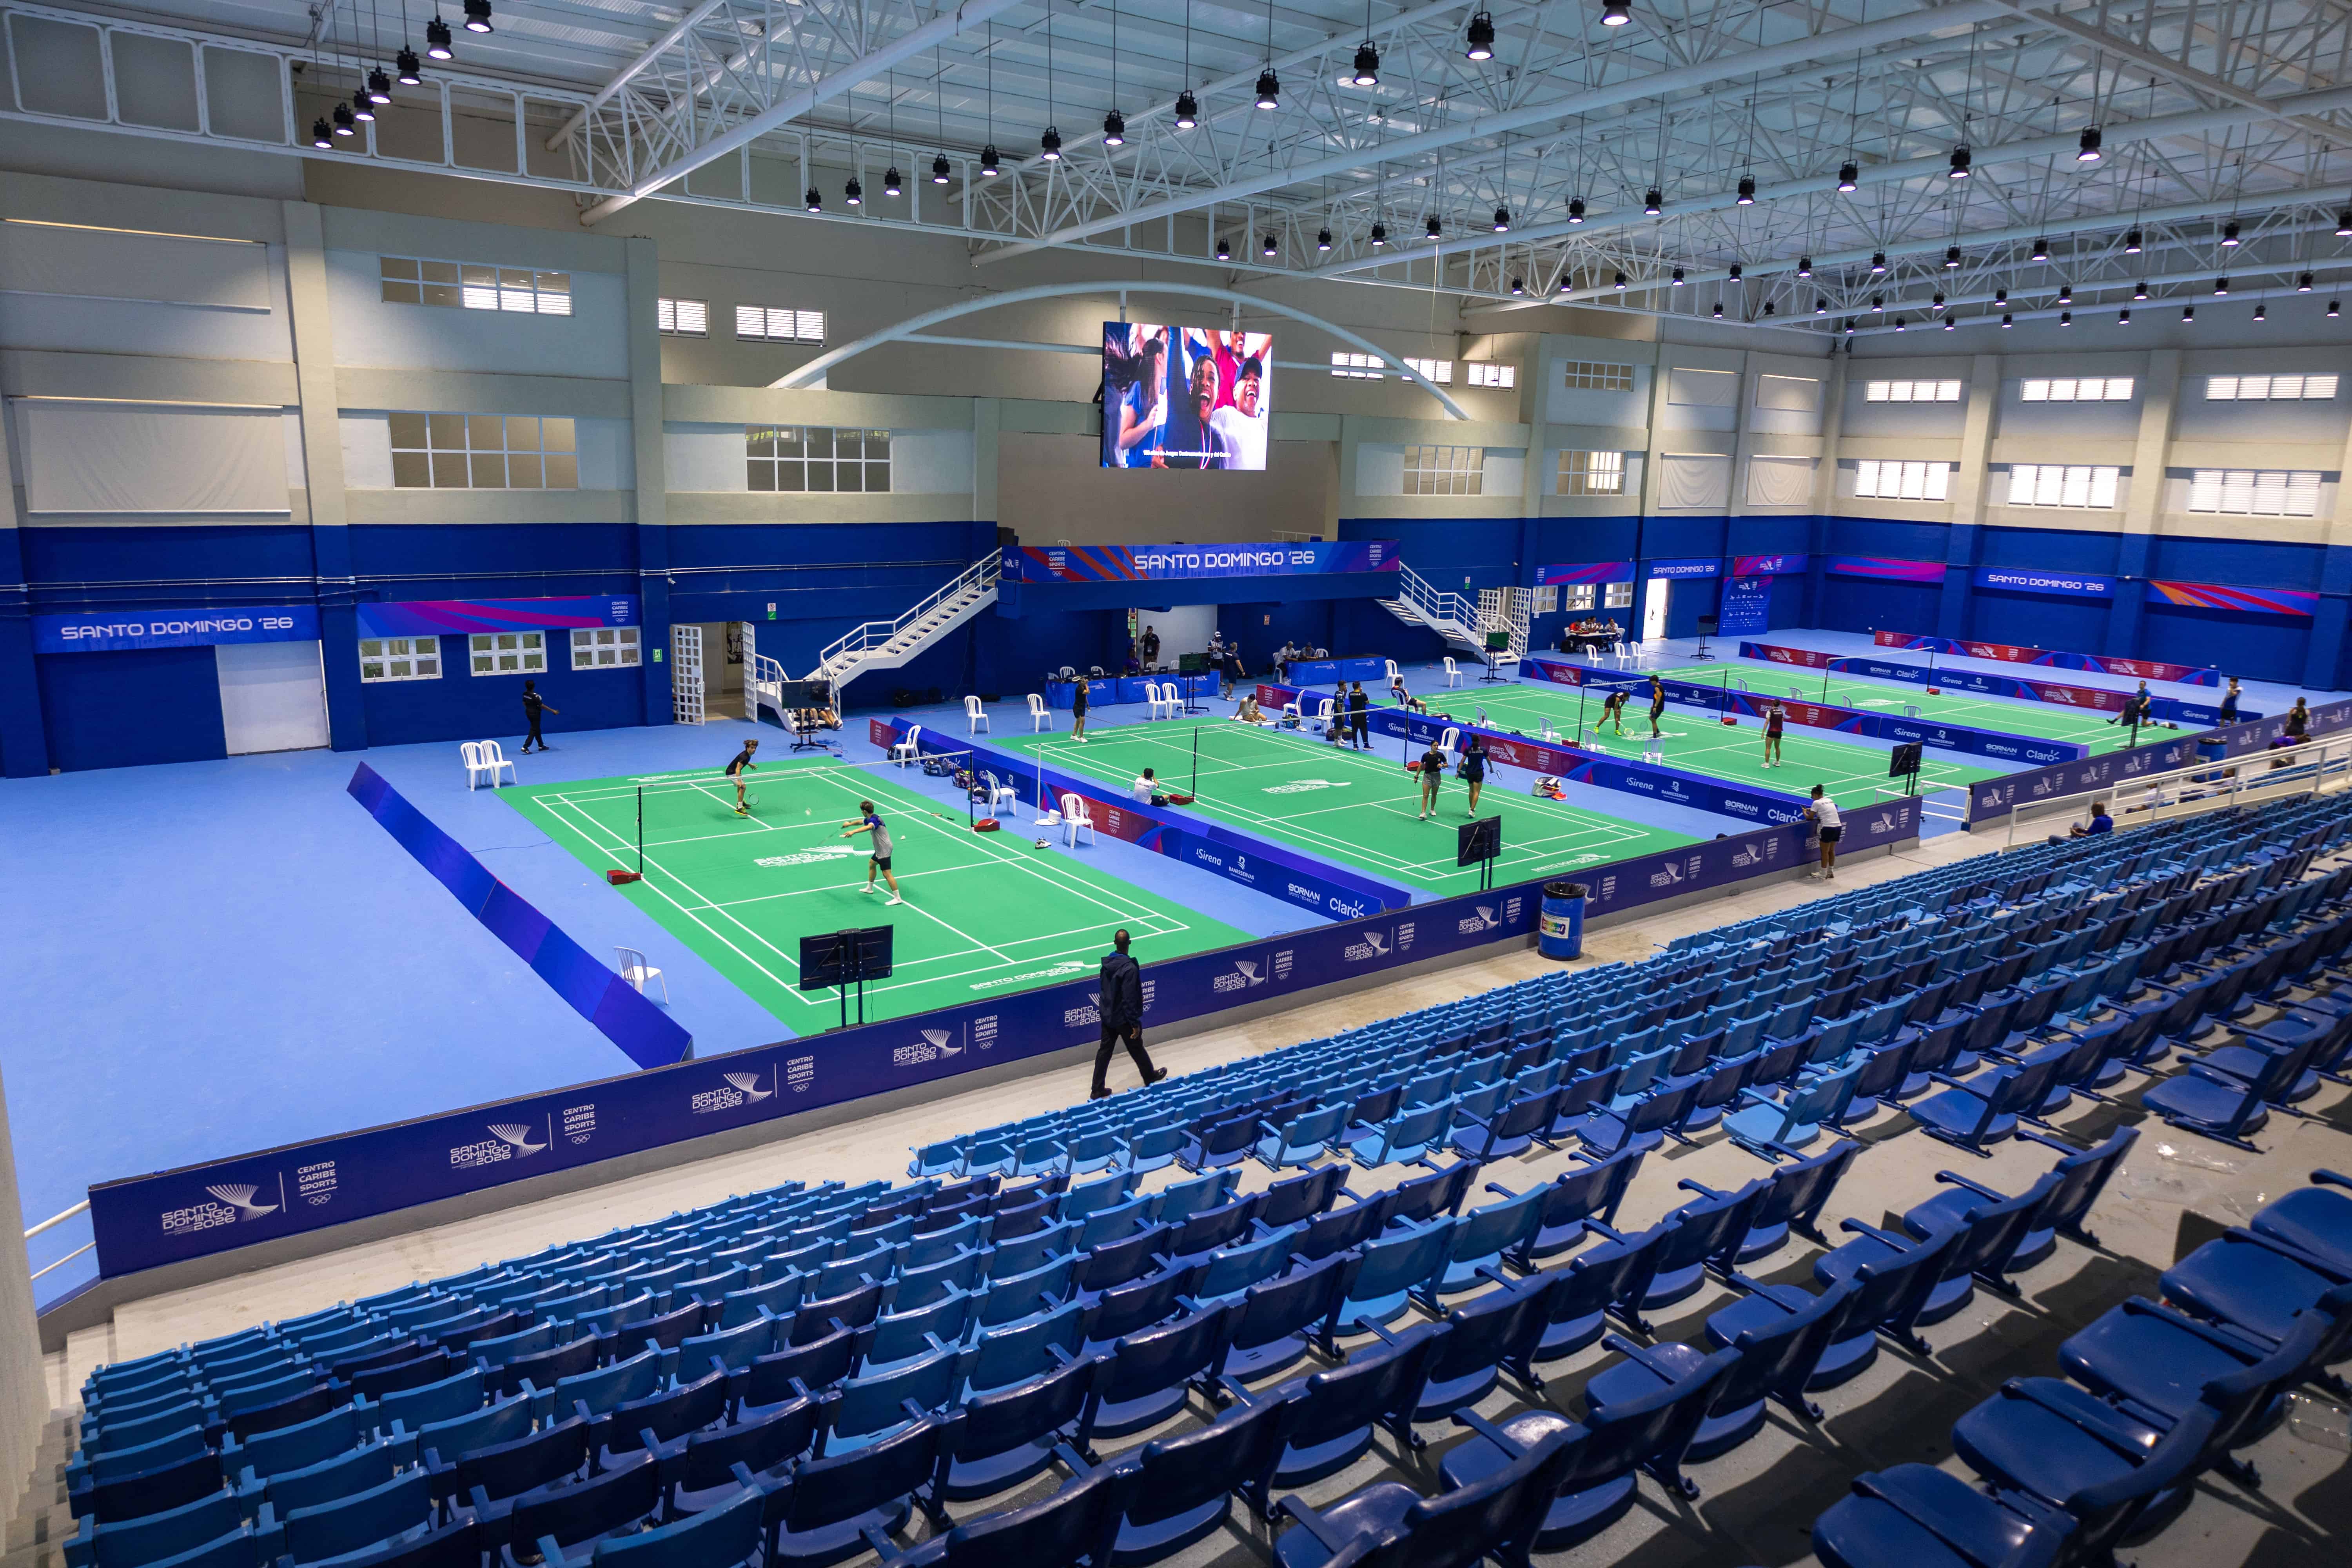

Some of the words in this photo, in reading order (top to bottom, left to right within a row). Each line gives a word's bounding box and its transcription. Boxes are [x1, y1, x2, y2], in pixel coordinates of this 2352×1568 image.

[1135, 554, 1200, 570] SANTO
[1205, 551, 1283, 567] DOMINGO
[1288, 550, 1315, 564] '26
[1988, 574, 2026, 585] SANTO
[2029, 577, 2082, 590] DOMINGO
[2084, 582, 2104, 591] '26
[61, 623, 144, 640] SANTO
[151, 618, 252, 635] DOMINGO
[258, 617, 294, 630] '26
[1896, 670, 1915, 679] Claro
[1664, 690, 1680, 698] irena
[1489, 748, 1508, 757] DOMINGO
[1985, 744, 2018, 753] BORNAN
[2026, 749, 2054, 761] Claro
[1661, 789, 1689, 800] BANRESERVAS
[1725, 800, 1758, 813] BORNAN
[1768, 809, 1798, 823] Claro
[1229, 866, 1254, 880] BANRESERVAS
[1288, 883, 1320, 902] BORNAN
[1300, 895, 1320, 906] TECHNOLOGY
[1330, 897, 1359, 918] Claro
[1459, 916, 1479, 926] SANTO
[1459, 920, 1484, 931] DOMINGO
[1345, 943, 1367, 953] SANTO
[1345, 946, 1373, 958] DOMINGO
[1275, 955, 1293, 964] CARIBE
[1356, 952, 1373, 960] 2026
[1275, 962, 1292, 970] SPORTS
[969, 977, 1013, 989] SANTO
[1014, 966, 1069, 979] DOMINGO
[1214, 972, 1239, 982] SANTO
[1214, 976, 1246, 989] DOMINGO
[1227, 982, 1246, 991] 2026
[1065, 1005, 1093, 1016] SANTO
[975, 1015, 998, 1024] CENTRO
[1080, 1015, 1101, 1025] 2026
[975, 1021, 998, 1031] CARIBE
[975, 1028, 998, 1038] SPORTS
[893, 1042, 927, 1055] SANTO
[893, 1046, 936, 1062] DOMINGO
[787, 1055, 813, 1066] CENTRO
[911, 1053, 936, 1065] 2026
[787, 1062, 813, 1073] CARIBE
[787, 1069, 814, 1081] SPORTS
[692, 1087, 731, 1102] SANTO
[692, 1091, 742, 1109] DOMINGO
[563, 1104, 595, 1116] CENTRO
[713, 1098, 742, 1111] 2026
[564, 1111, 595, 1124] CARIBE
[564, 1119, 596, 1132] SPORTS
[450, 1140, 497, 1156] SANTO
[451, 1144, 511, 1164] DOMINGO
[476, 1151, 512, 1166] 2026
[297, 1160, 336, 1175] CENTRO
[298, 1169, 336, 1183] CARIBE
[299, 1177, 337, 1192] SPORTS
[162, 1202, 218, 1222] SANTO
[163, 1206, 235, 1230] DOMINGO
[194, 1214, 236, 1231] 2026
